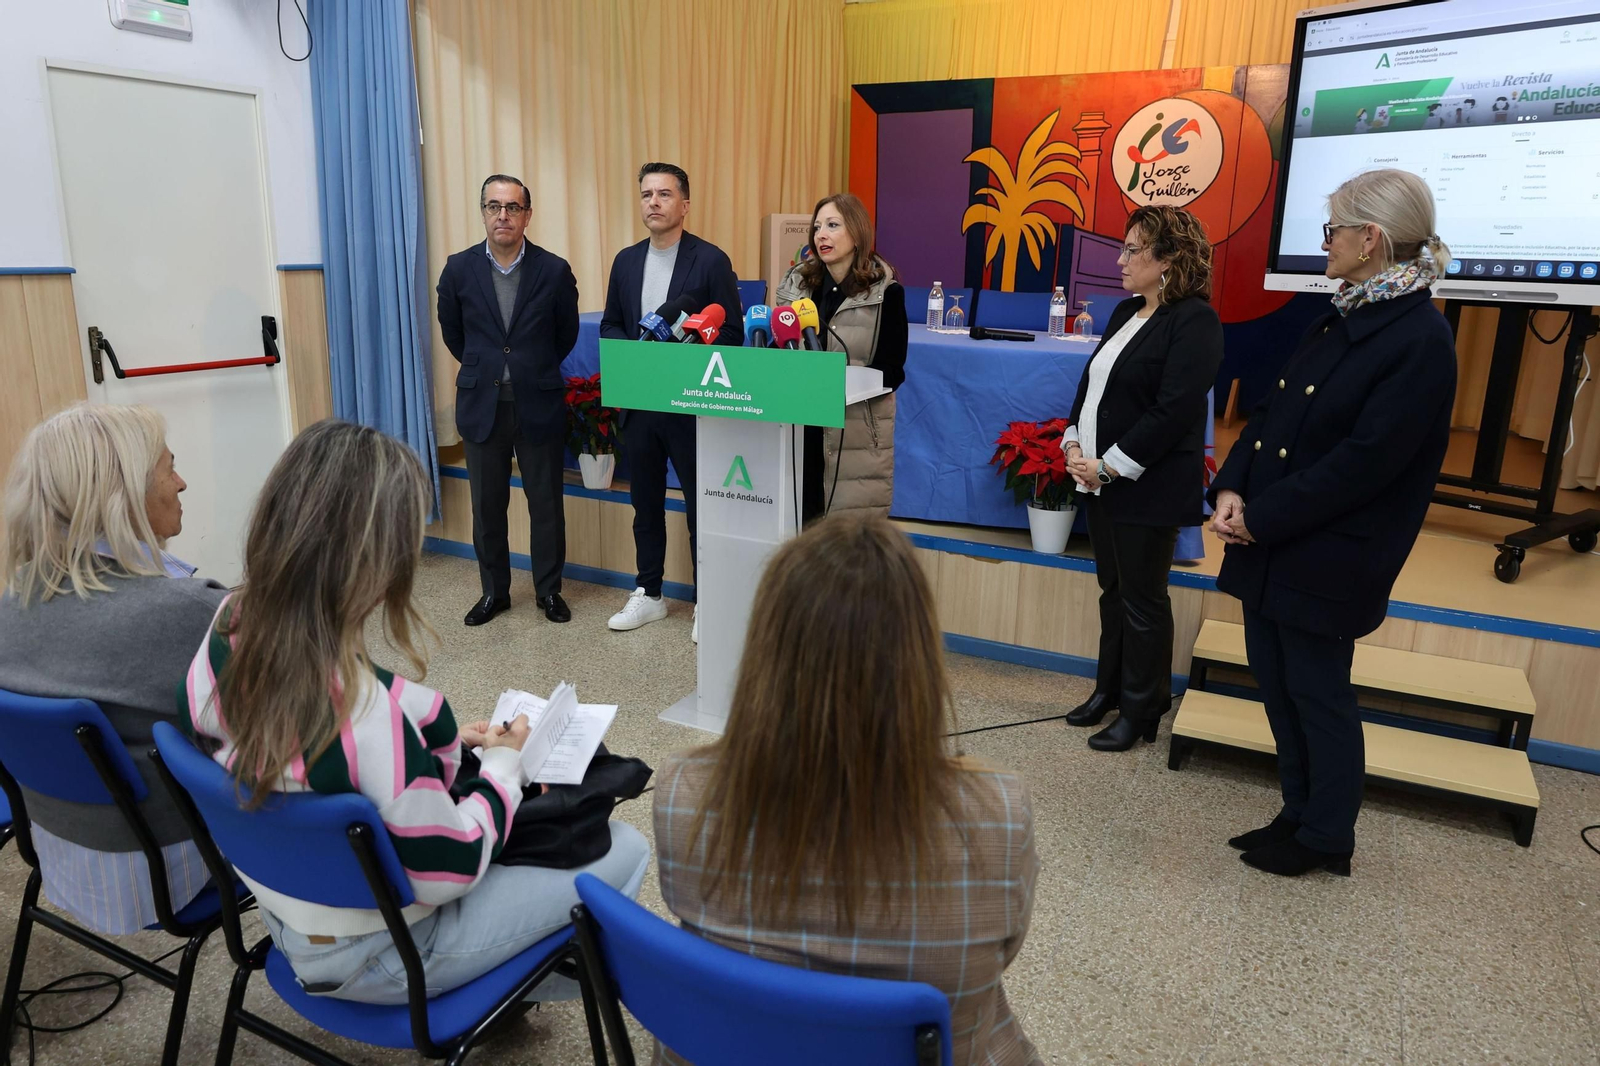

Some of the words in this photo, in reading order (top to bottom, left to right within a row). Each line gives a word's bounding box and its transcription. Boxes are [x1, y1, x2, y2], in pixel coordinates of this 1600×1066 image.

[1461, 80, 1490, 90] Vuelve
[1492, 79, 1500, 87] la
[1502, 72, 1553, 86] Revista
[1517, 82, 1600, 102] Andalucía
[1143, 162, 1190, 181] Jorge
[1141, 179, 1199, 201] Guillén
[682, 388, 702, 396] Junta
[704, 390, 713, 398] de
[714, 391, 752, 400] Andalucía
[671, 400, 700, 408] Delegación
[743, 406, 763, 414] Málaga
[704, 488, 724, 497] Junta
[726, 491, 735, 499] de
[736, 493, 773, 504] Andalucía
